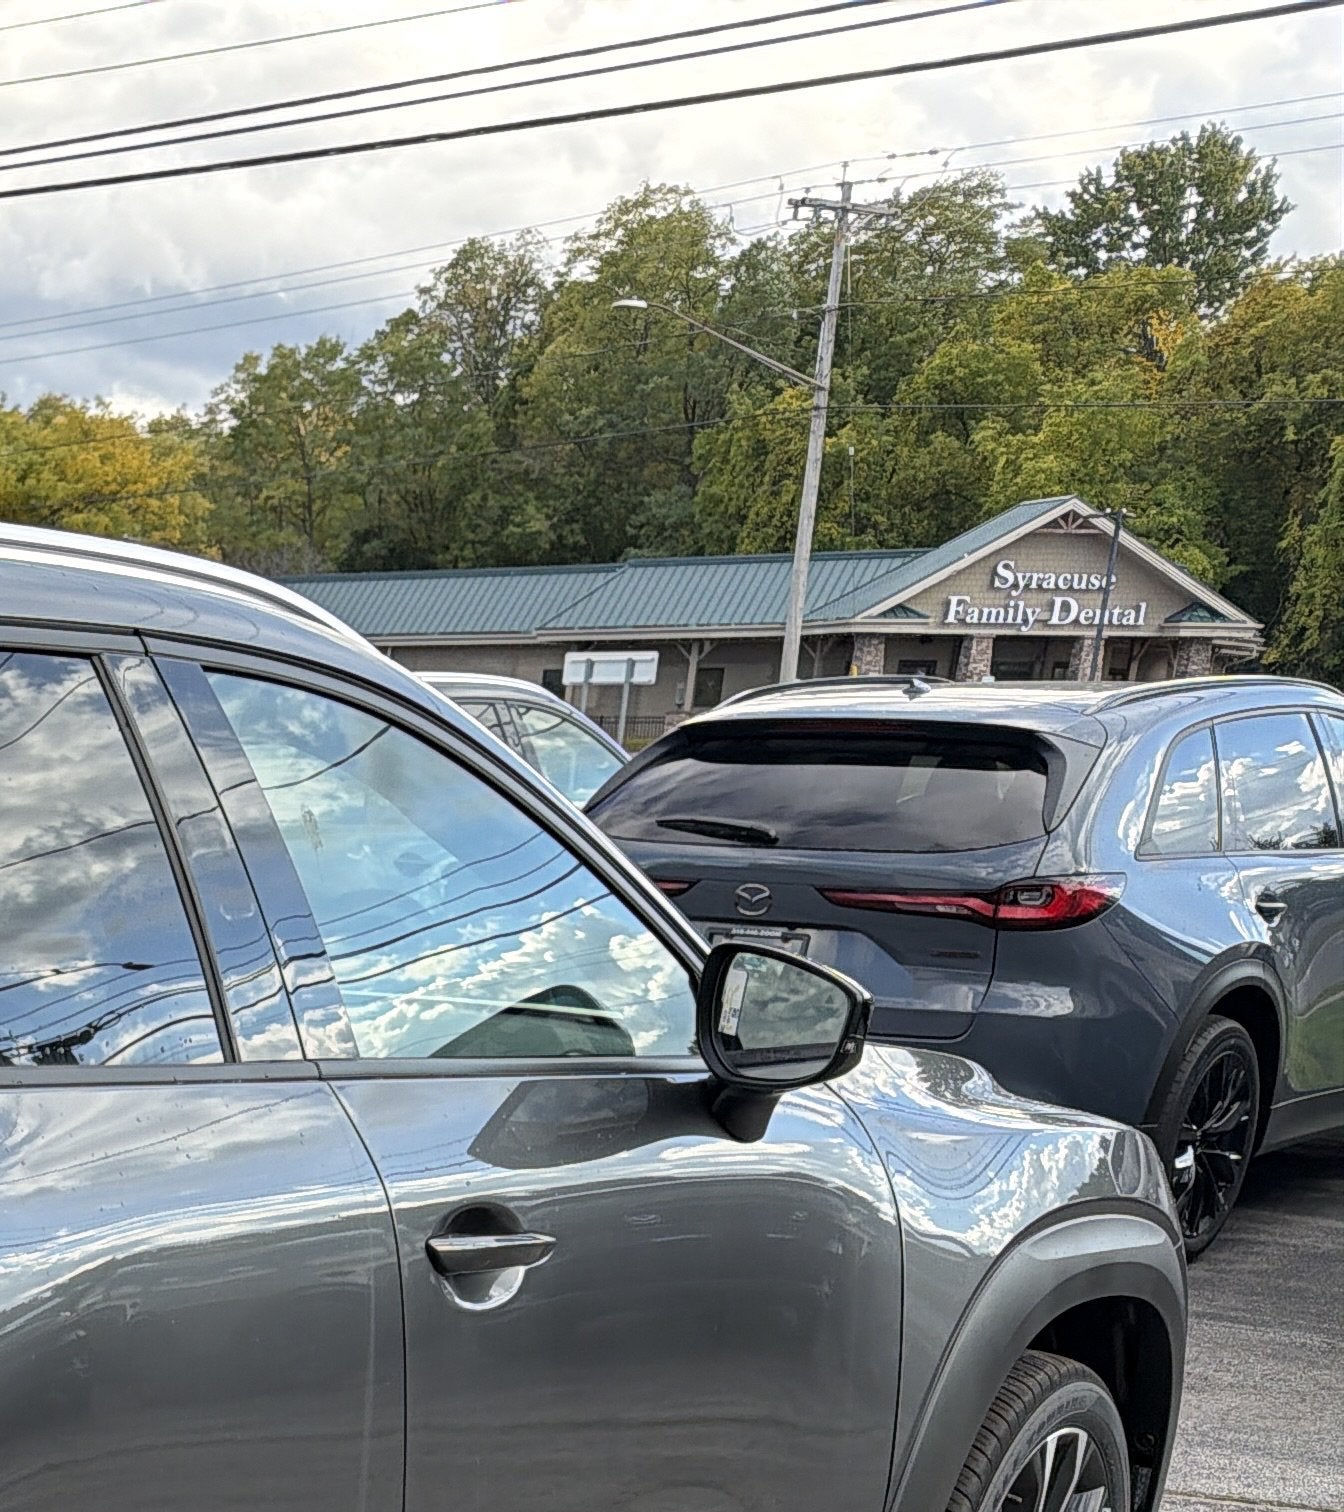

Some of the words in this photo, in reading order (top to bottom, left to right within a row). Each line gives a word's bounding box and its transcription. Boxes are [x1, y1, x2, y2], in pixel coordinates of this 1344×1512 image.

[994, 560, 1117, 596] Syracuse
[944, 595, 1041, 632] Family
[1047, 596, 1147, 626] Dental
